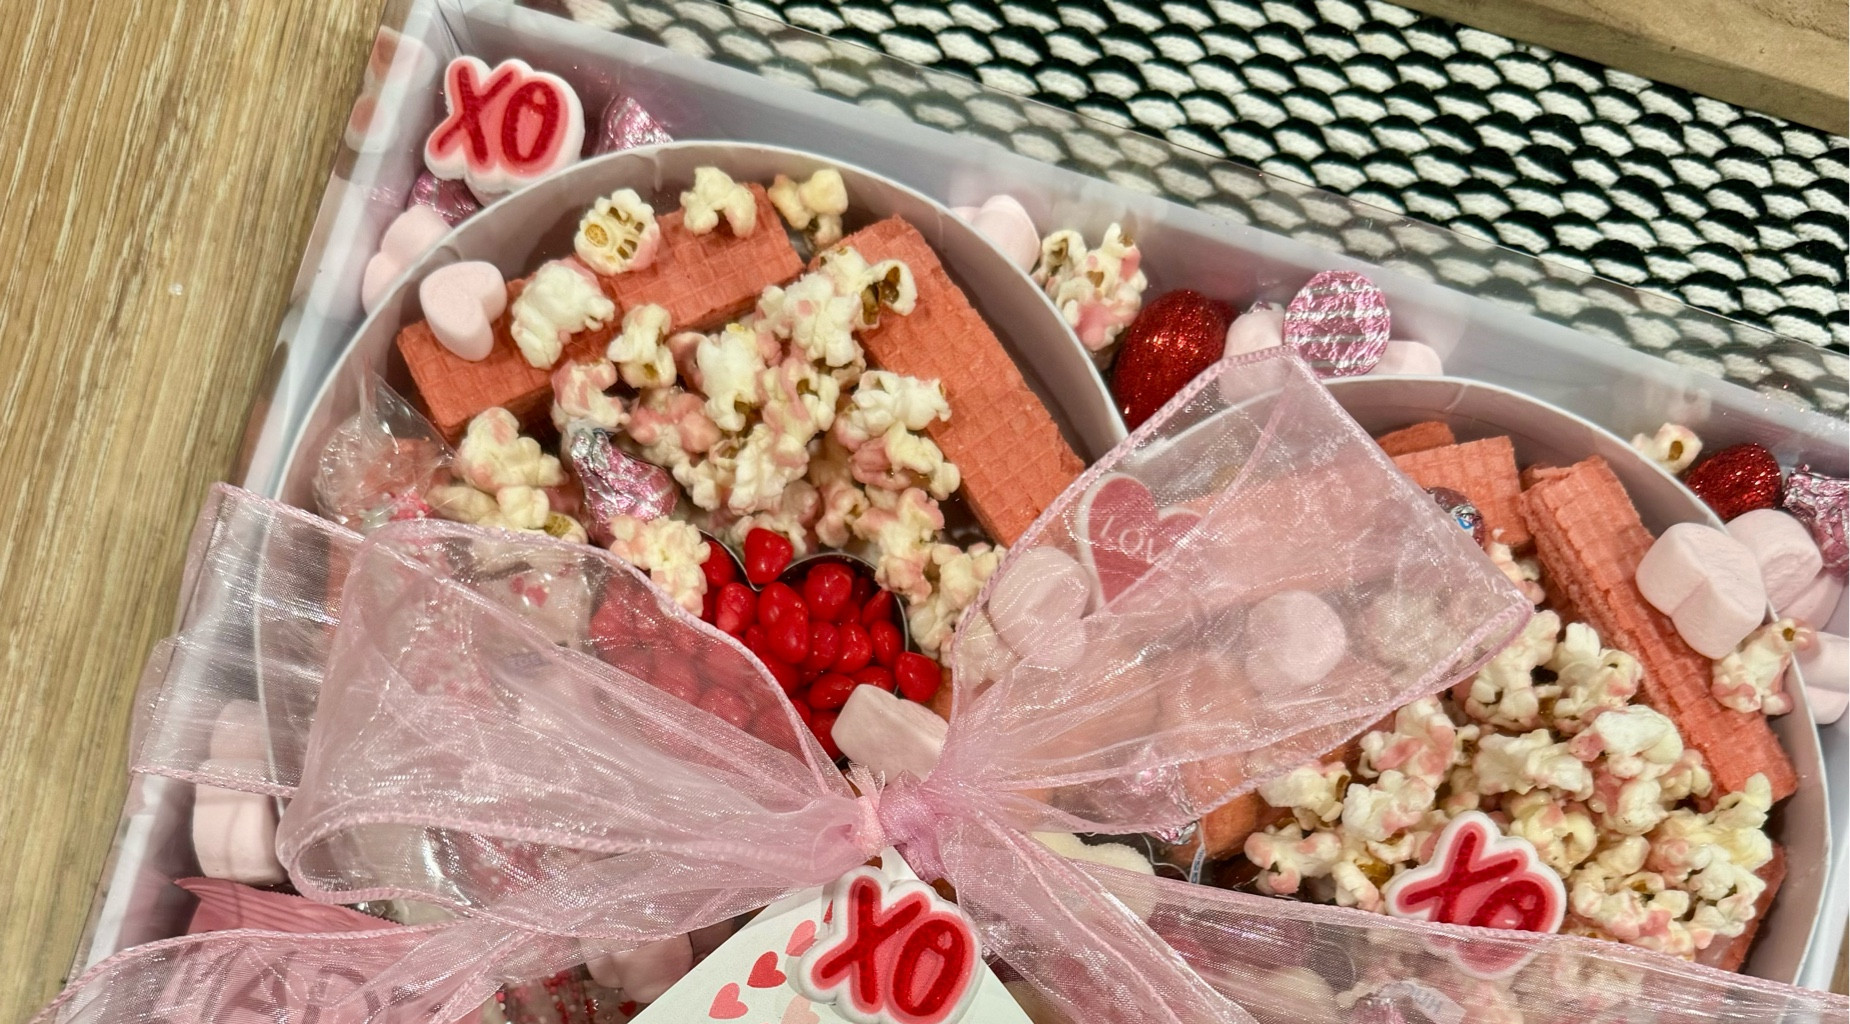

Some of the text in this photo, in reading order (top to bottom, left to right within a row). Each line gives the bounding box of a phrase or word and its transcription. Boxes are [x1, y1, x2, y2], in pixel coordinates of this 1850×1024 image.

[438, 66, 560, 164] XO
[1100, 514, 1174, 565] LOV
[820, 884, 965, 1017] XO
